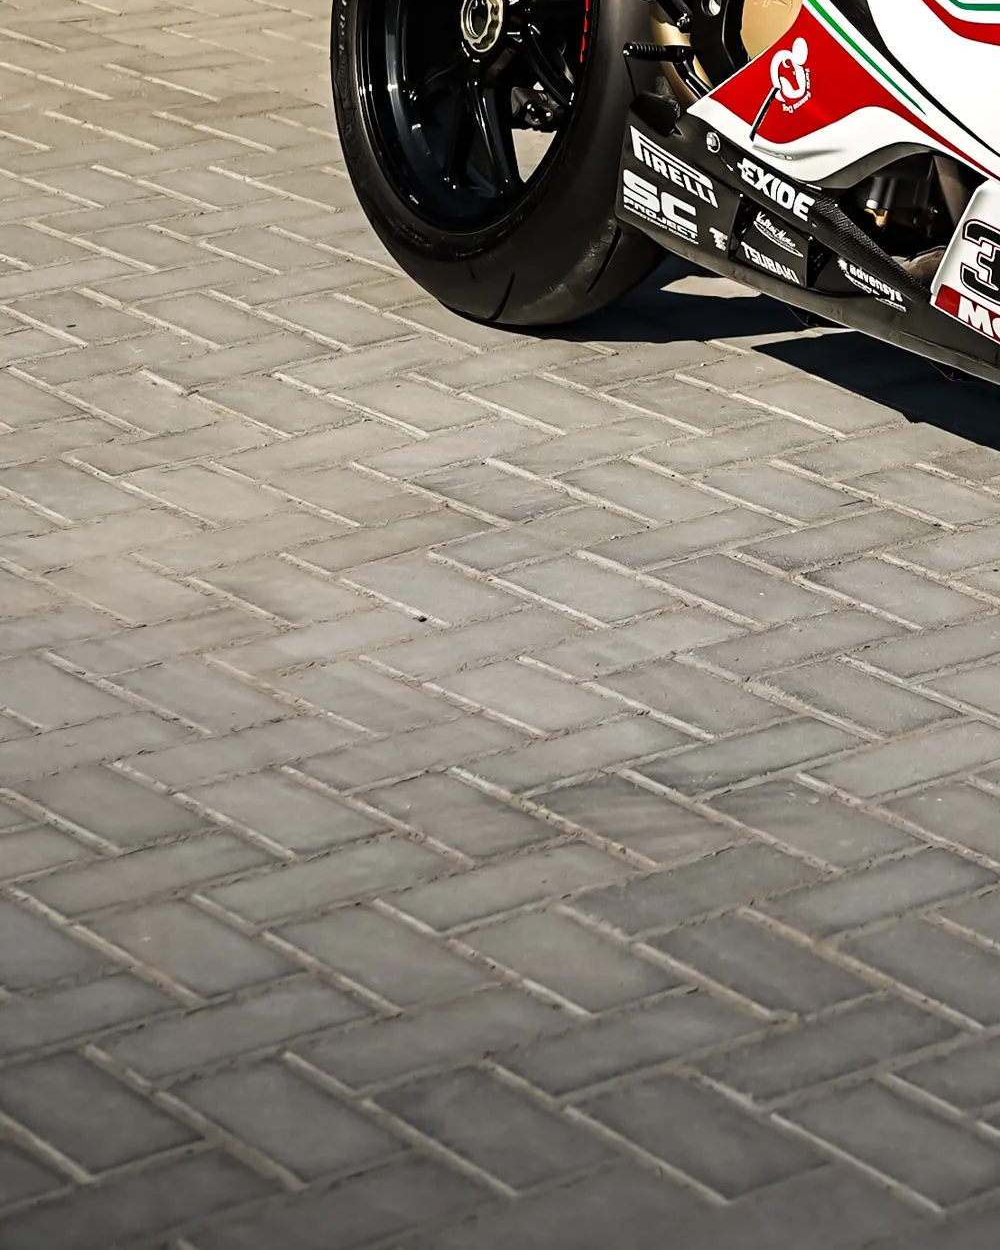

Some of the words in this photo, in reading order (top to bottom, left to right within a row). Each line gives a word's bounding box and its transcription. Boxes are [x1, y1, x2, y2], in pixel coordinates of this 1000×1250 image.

[629, 124, 719, 209] PIRELLI
[737, 157, 816, 222] EXIDE
[622, 168, 698, 234] SC
[622, 195, 699, 240] PROJECT
[740, 240, 801, 285] TSUBAKI
